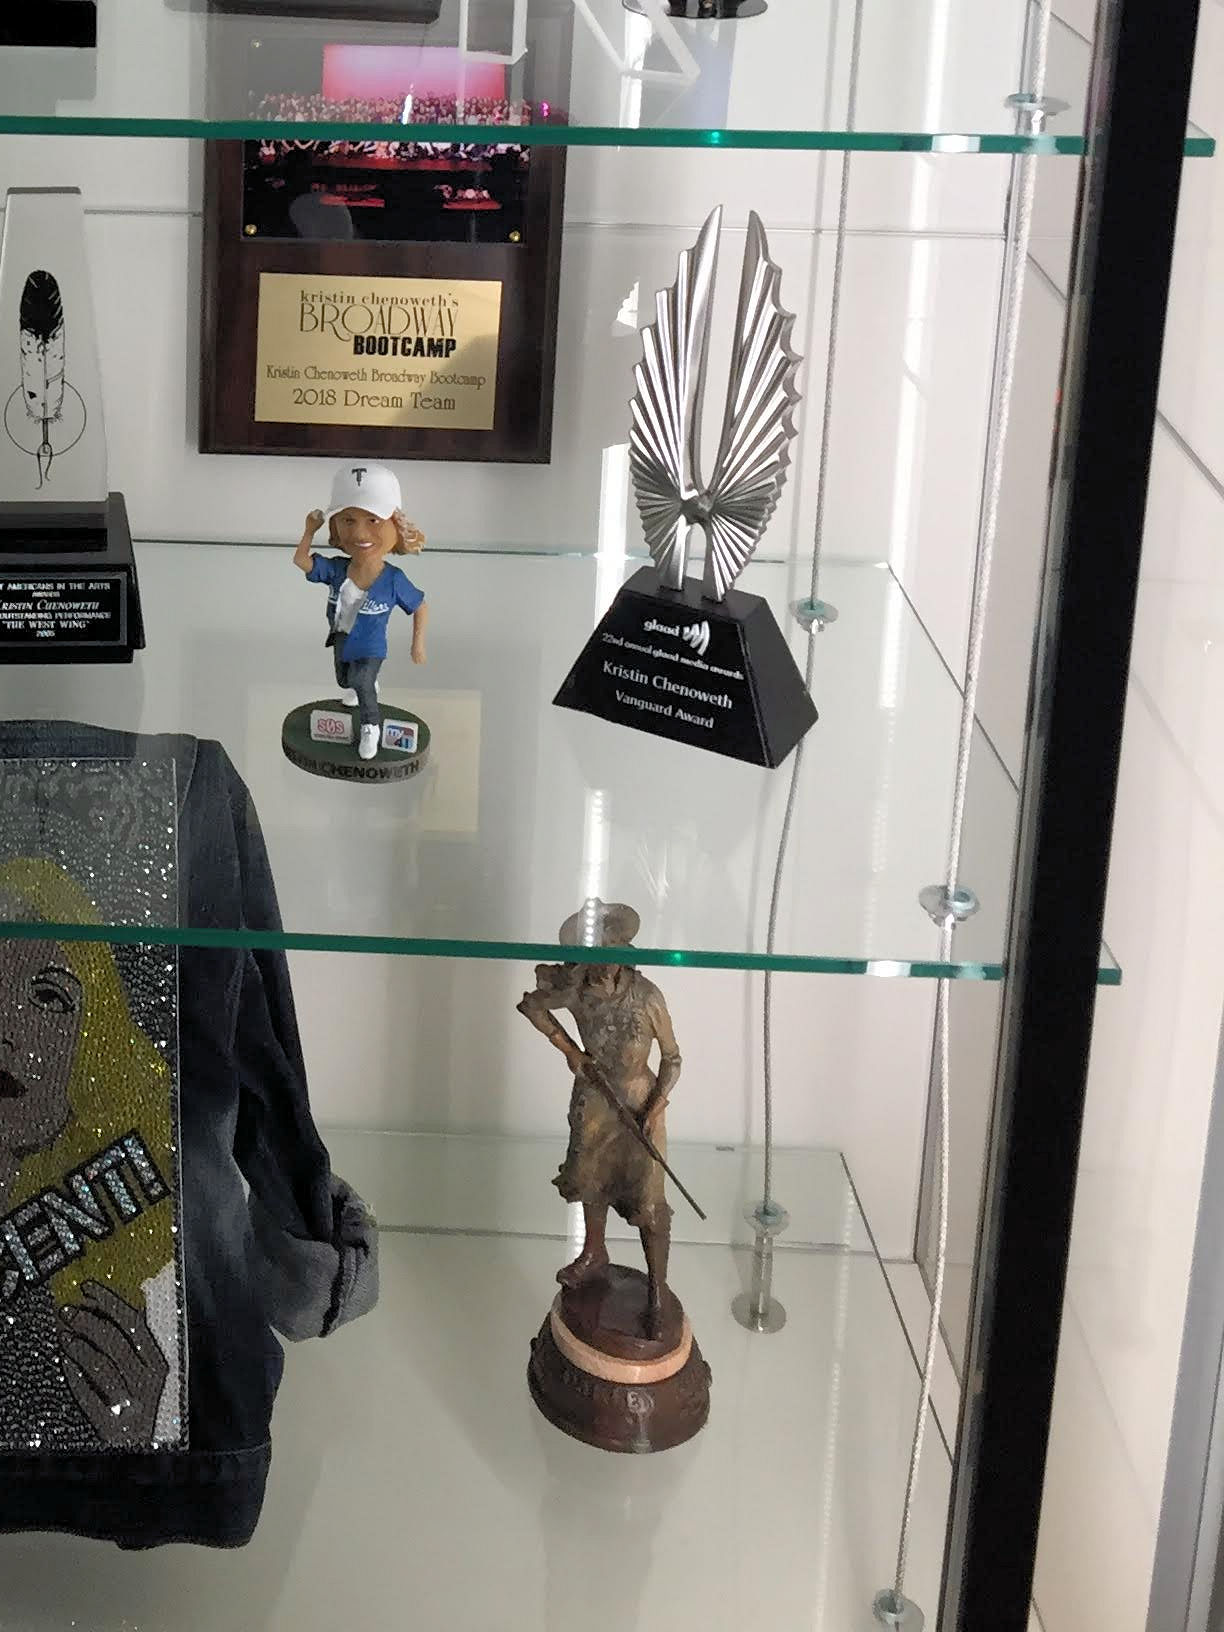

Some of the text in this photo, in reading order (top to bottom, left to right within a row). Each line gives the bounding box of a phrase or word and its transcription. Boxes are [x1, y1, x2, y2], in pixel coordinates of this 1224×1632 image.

[300, 290, 460, 307] kristin chenoweth's
[299, 302, 460, 342] BROADWAY
[353, 334, 457, 358] BOOTCAMP
[266, 364, 486, 390] Kristin Chenoweth Broadway Bootcamp
[292, 388, 456, 411] 2018 Dream Team
[351, 467, 367, 486] T
[36, 598, 100, 611] CHENOWETH
[28, 620, 56, 630] WEST
[643, 618, 680, 638] glaad
[602, 631, 624, 648] 22nd
[651, 646, 679, 663] glaad
[680, 653, 709, 671] media
[709, 663, 745, 681] awards
[602, 660, 733, 710] Kristin Chenoweth
[615, 690, 715, 729] Vanguard Award
